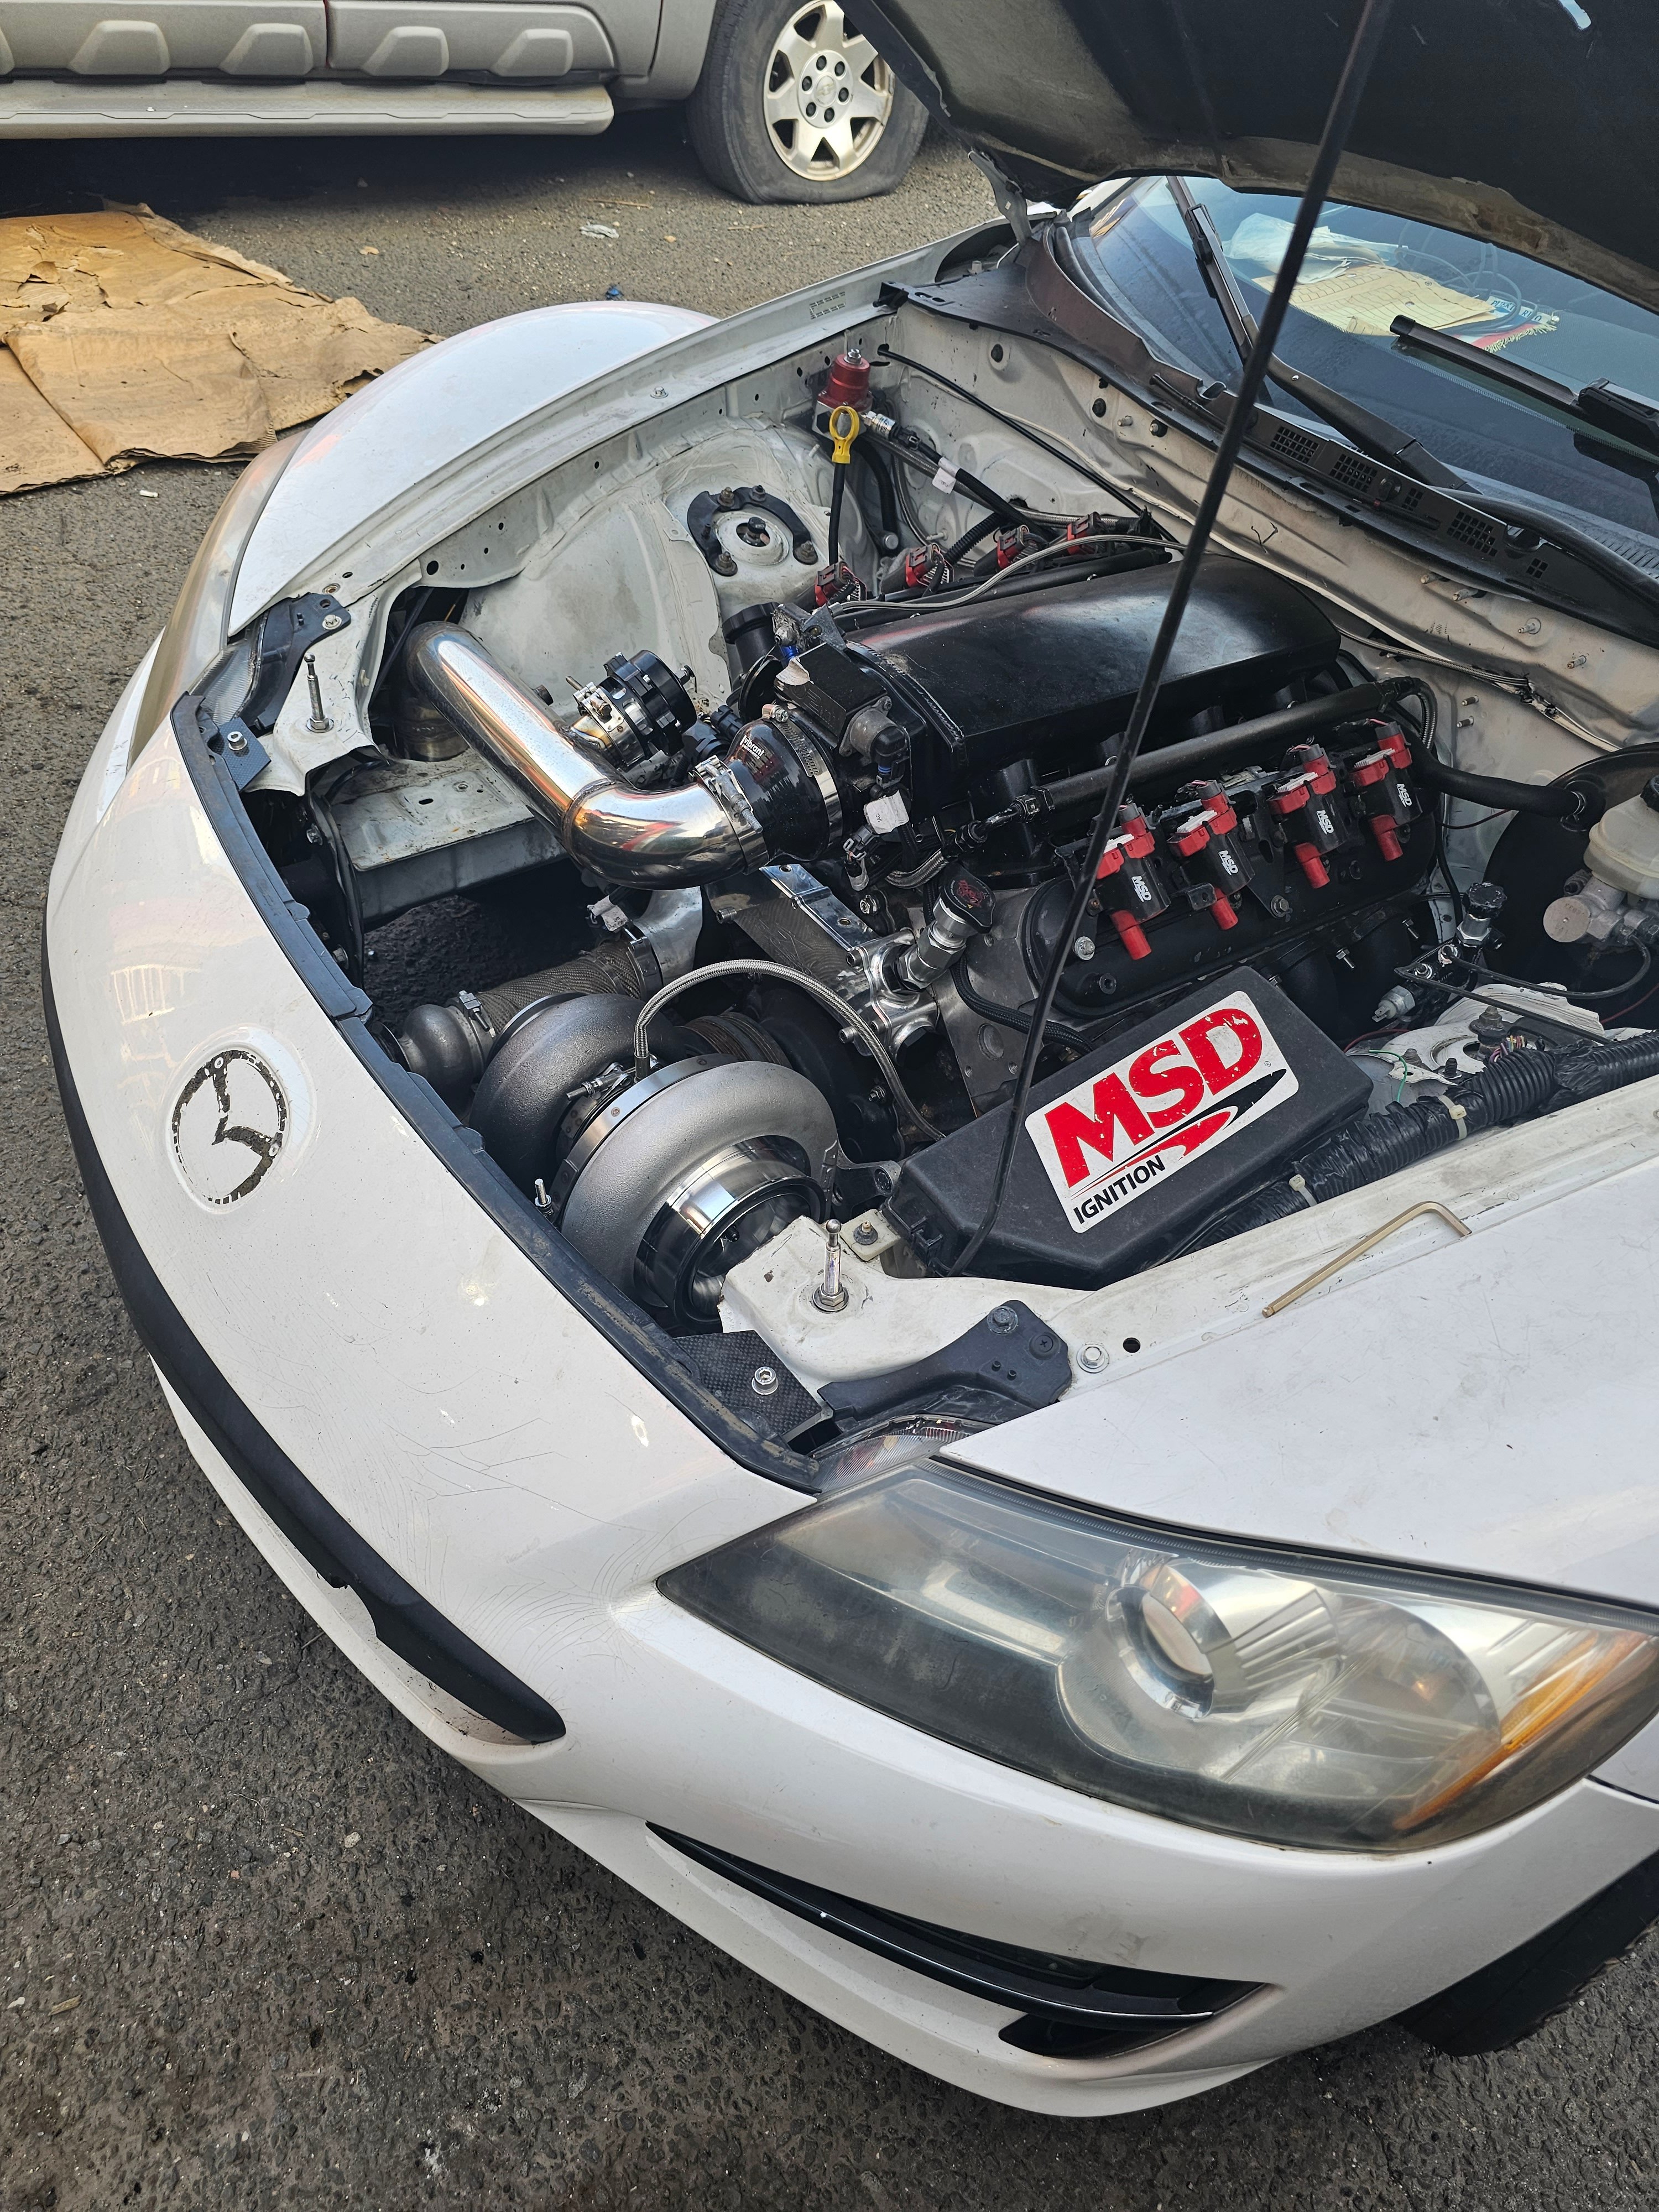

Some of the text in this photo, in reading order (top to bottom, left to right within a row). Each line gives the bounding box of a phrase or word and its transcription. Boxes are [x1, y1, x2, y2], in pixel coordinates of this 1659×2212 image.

[1491, 300, 1542, 321] PUERT RIO
[742, 735, 764, 757] vibrant
[1396, 784, 1412, 806] MSD
[1316, 810, 1334, 833] MSD
[1218, 850, 1239, 874] MSD
[1131, 875, 1152, 901] MSD
[1045, 1008, 1262, 1188] MSD
[1073, 1155, 1166, 1224] IGNITION
